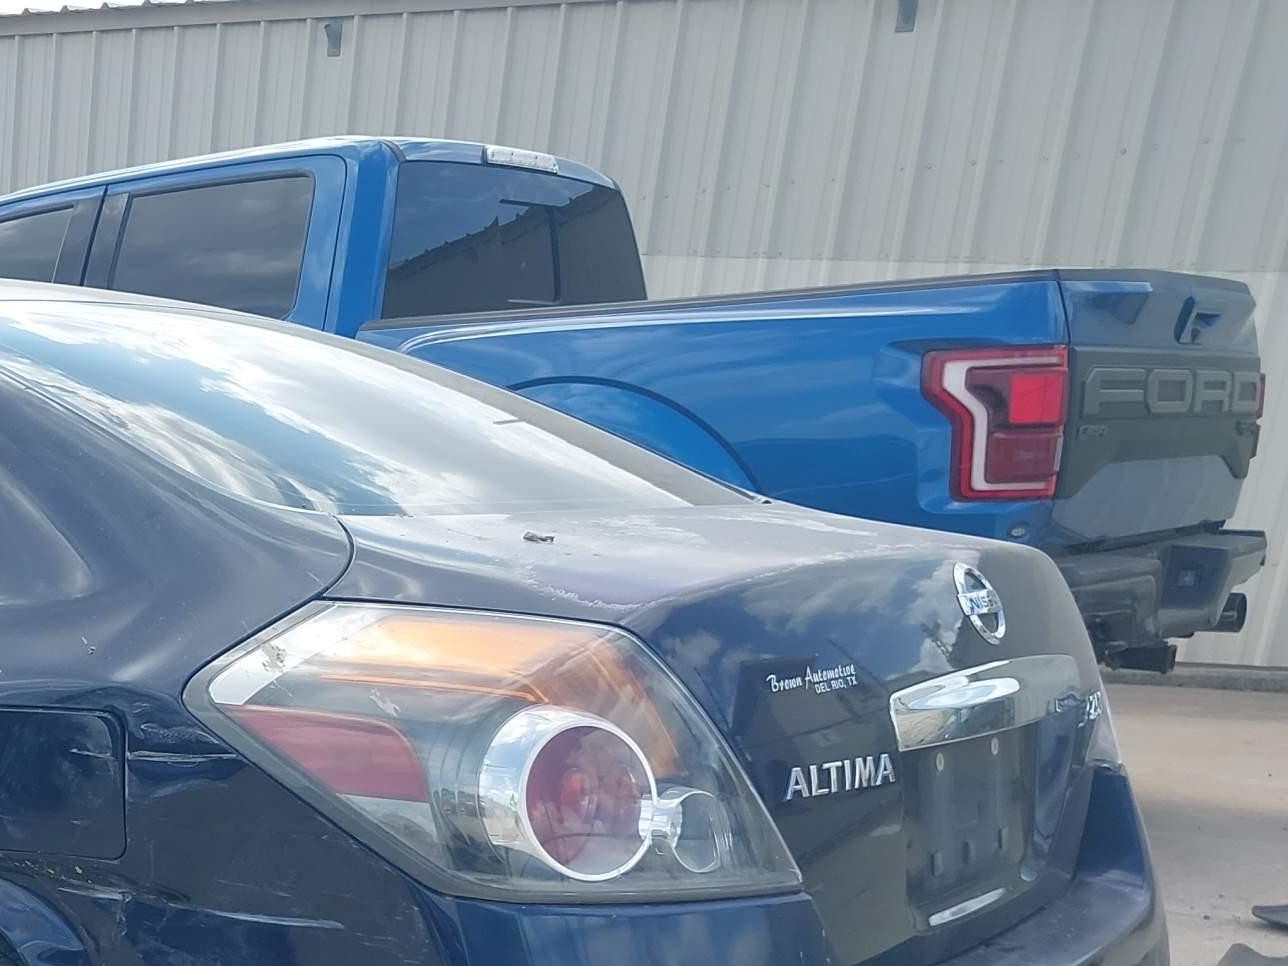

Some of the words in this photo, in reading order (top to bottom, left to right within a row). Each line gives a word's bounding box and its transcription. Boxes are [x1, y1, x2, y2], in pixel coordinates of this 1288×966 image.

[1082, 367, 1260, 416] FORD
[766, 674, 802, 691] Brown
[805, 664, 856, 688] Automotive
[815, 683, 831, 693] DEL
[847, 676, 857, 685] TX
[785, 754, 896, 800] ALTIMA
